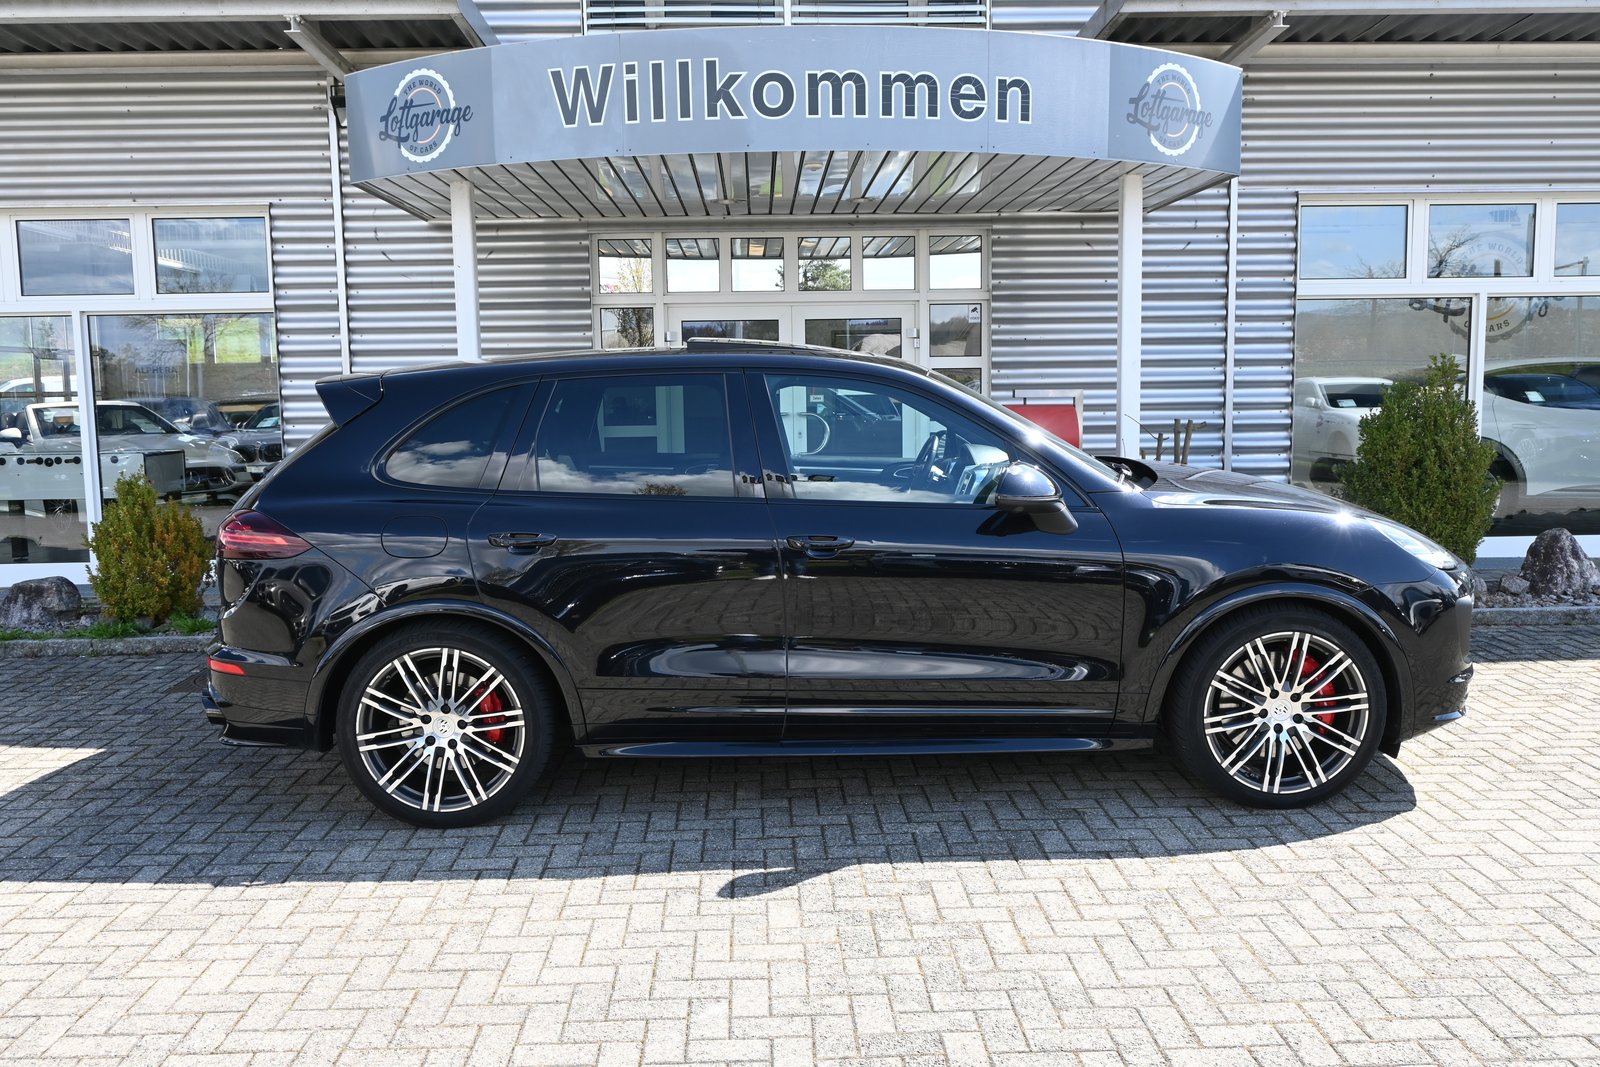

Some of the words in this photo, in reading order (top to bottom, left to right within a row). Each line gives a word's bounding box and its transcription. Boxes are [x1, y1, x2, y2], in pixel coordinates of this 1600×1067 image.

[404, 81, 417, 95] THE
[418, 79, 442, 95] WORLD
[547, 56, 1033, 128] Willkommen
[1158, 75, 1169, 85] THE
[1172, 75, 1191, 95] WORLD
[1126, 82, 1213, 139] Loftgarage
[378, 96, 474, 149] Loftgarage
[410, 144, 418, 153] OF
[420, 141, 438, 153] CARS
[1487, 242, 1524, 264] WORLD
[1486, 320, 1510, 332] ARS
[134, 366, 178, 374] ALPHERA
